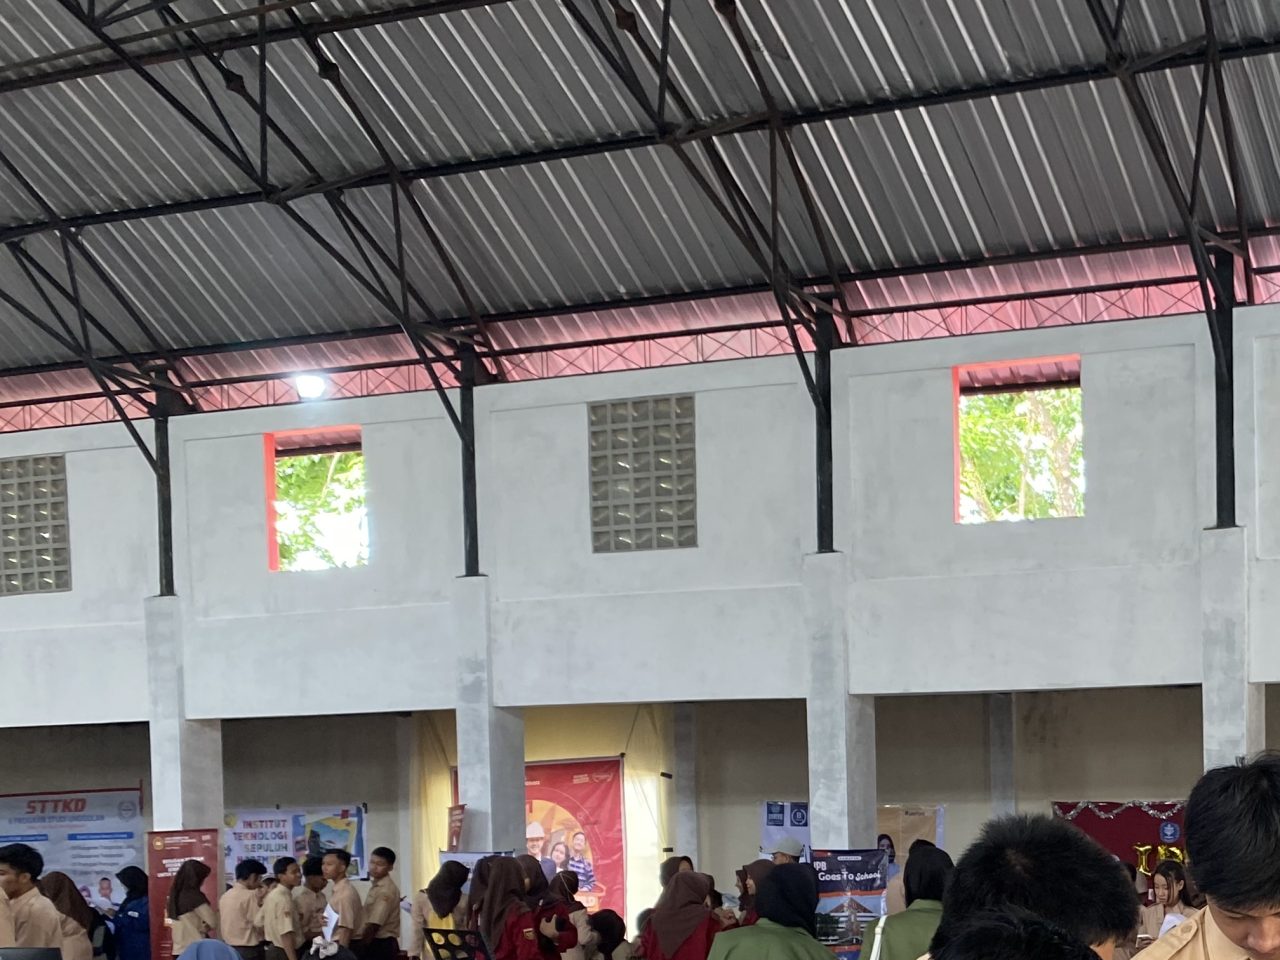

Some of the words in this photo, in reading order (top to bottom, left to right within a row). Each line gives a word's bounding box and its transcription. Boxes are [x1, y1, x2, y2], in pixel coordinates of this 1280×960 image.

[26, 798, 87, 814] STTKD
[242, 819, 287, 829] INSTITUT
[233, 831, 288, 841] TEKNOLOGI
[244, 843, 288, 852] SEPULUH
[818, 872, 841, 881] Goes
[841, 871, 854, 880] To
[855, 870, 881, 881] School
